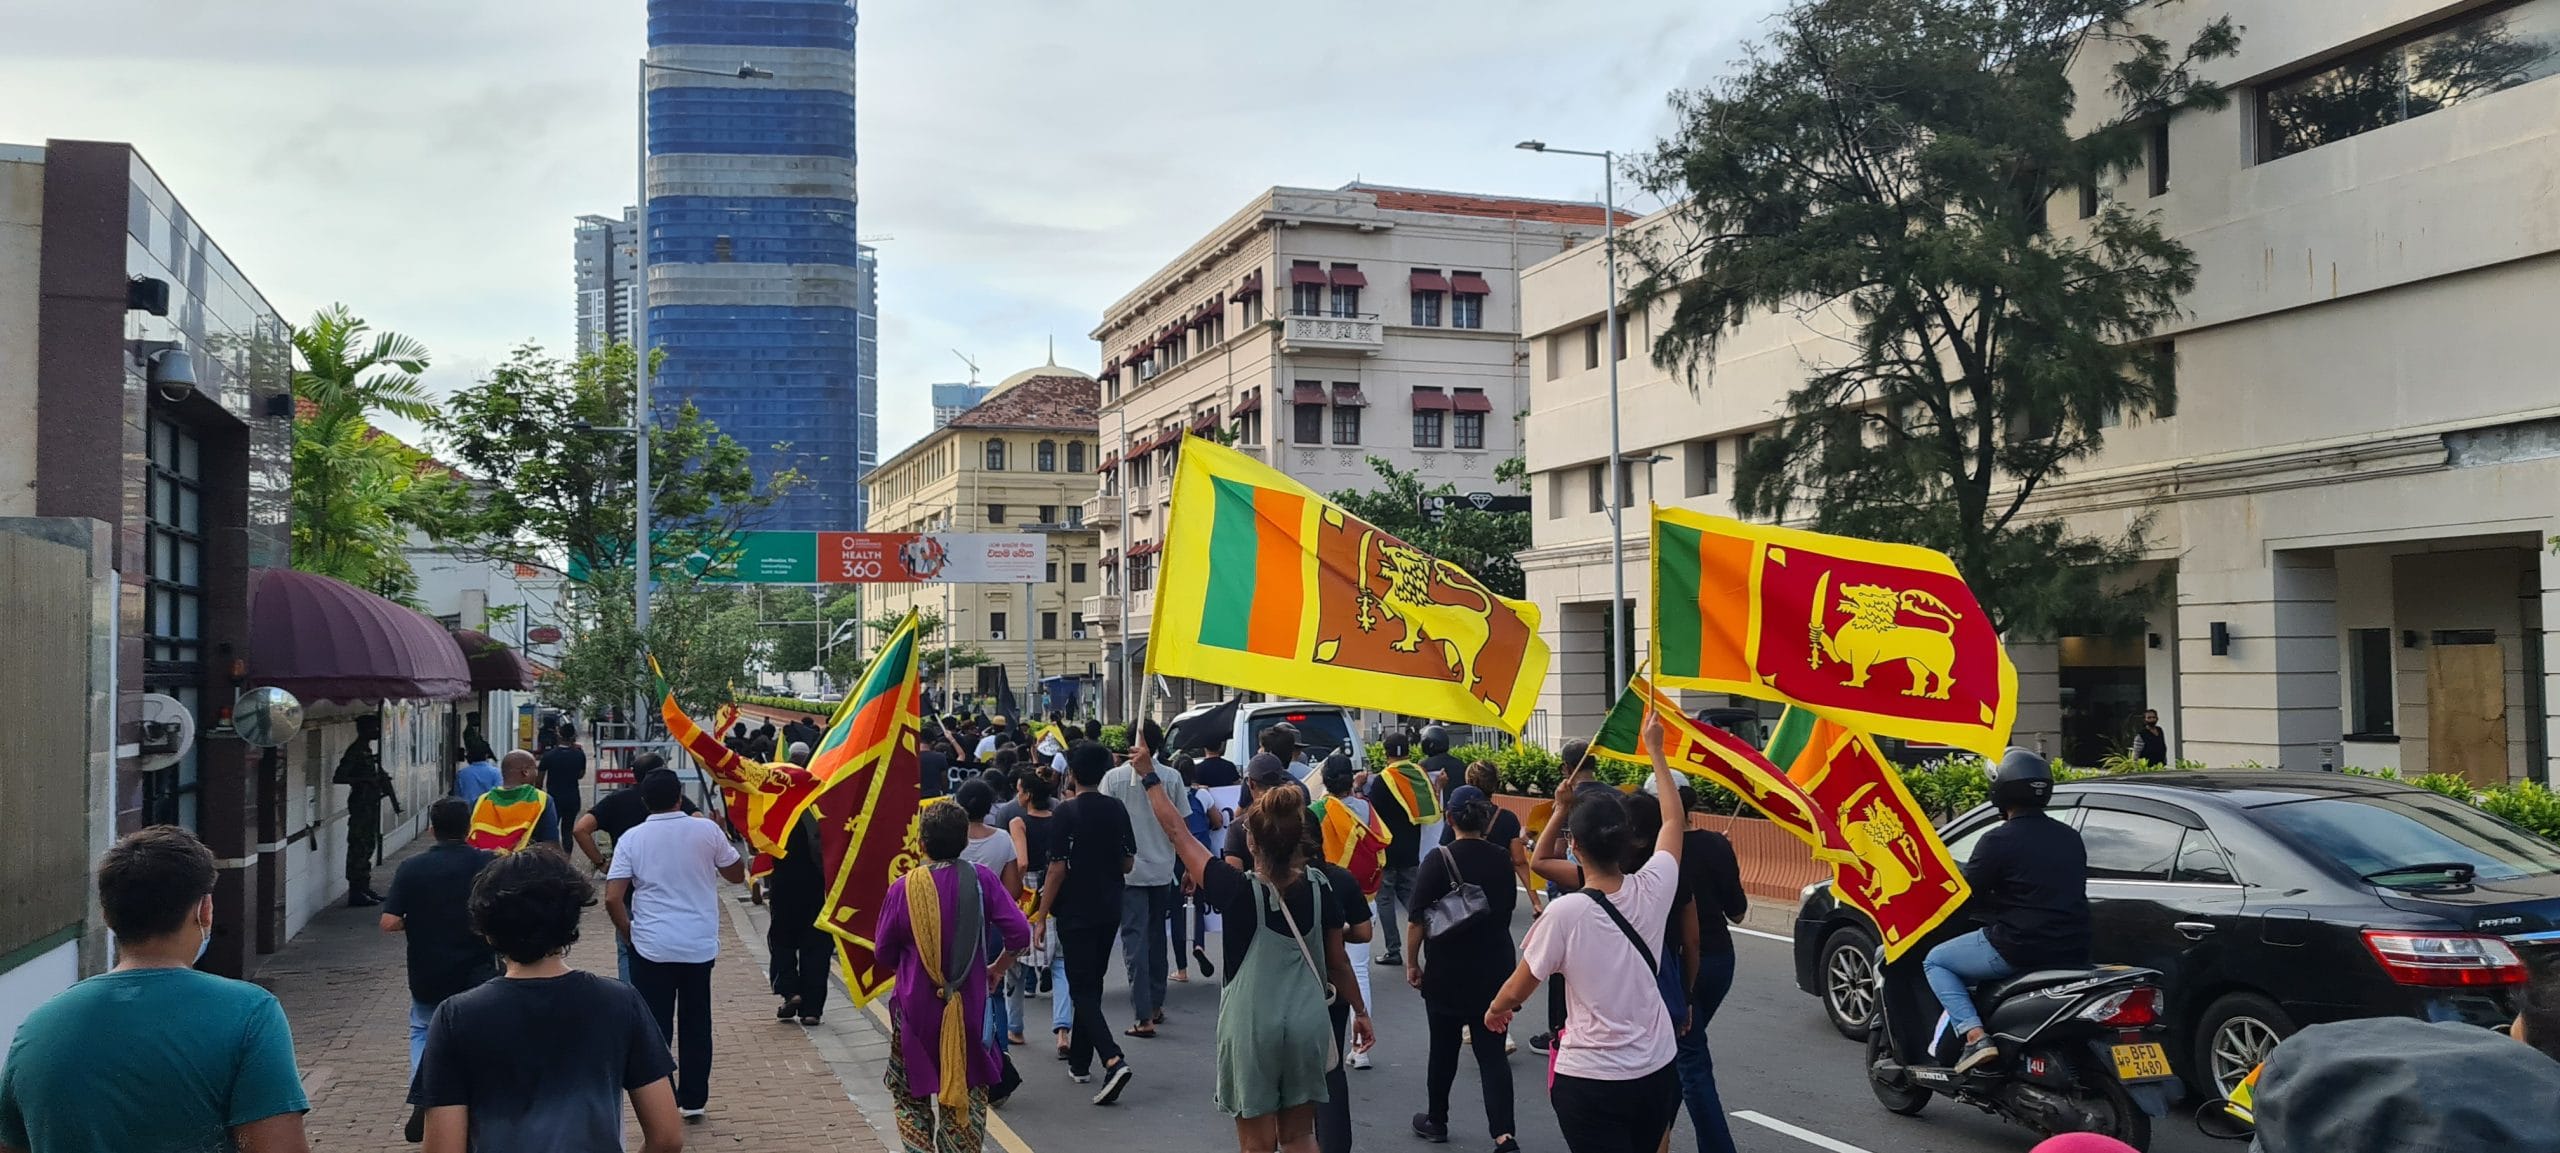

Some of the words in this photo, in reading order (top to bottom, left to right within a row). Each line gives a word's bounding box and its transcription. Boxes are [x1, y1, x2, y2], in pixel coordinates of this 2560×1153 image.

[842, 551, 882, 559] HEALTH
[842, 561, 882, 578] 360
[2129, 1045, 2157, 1060] BFD
[1915, 1071, 1949, 1082] HONDA
